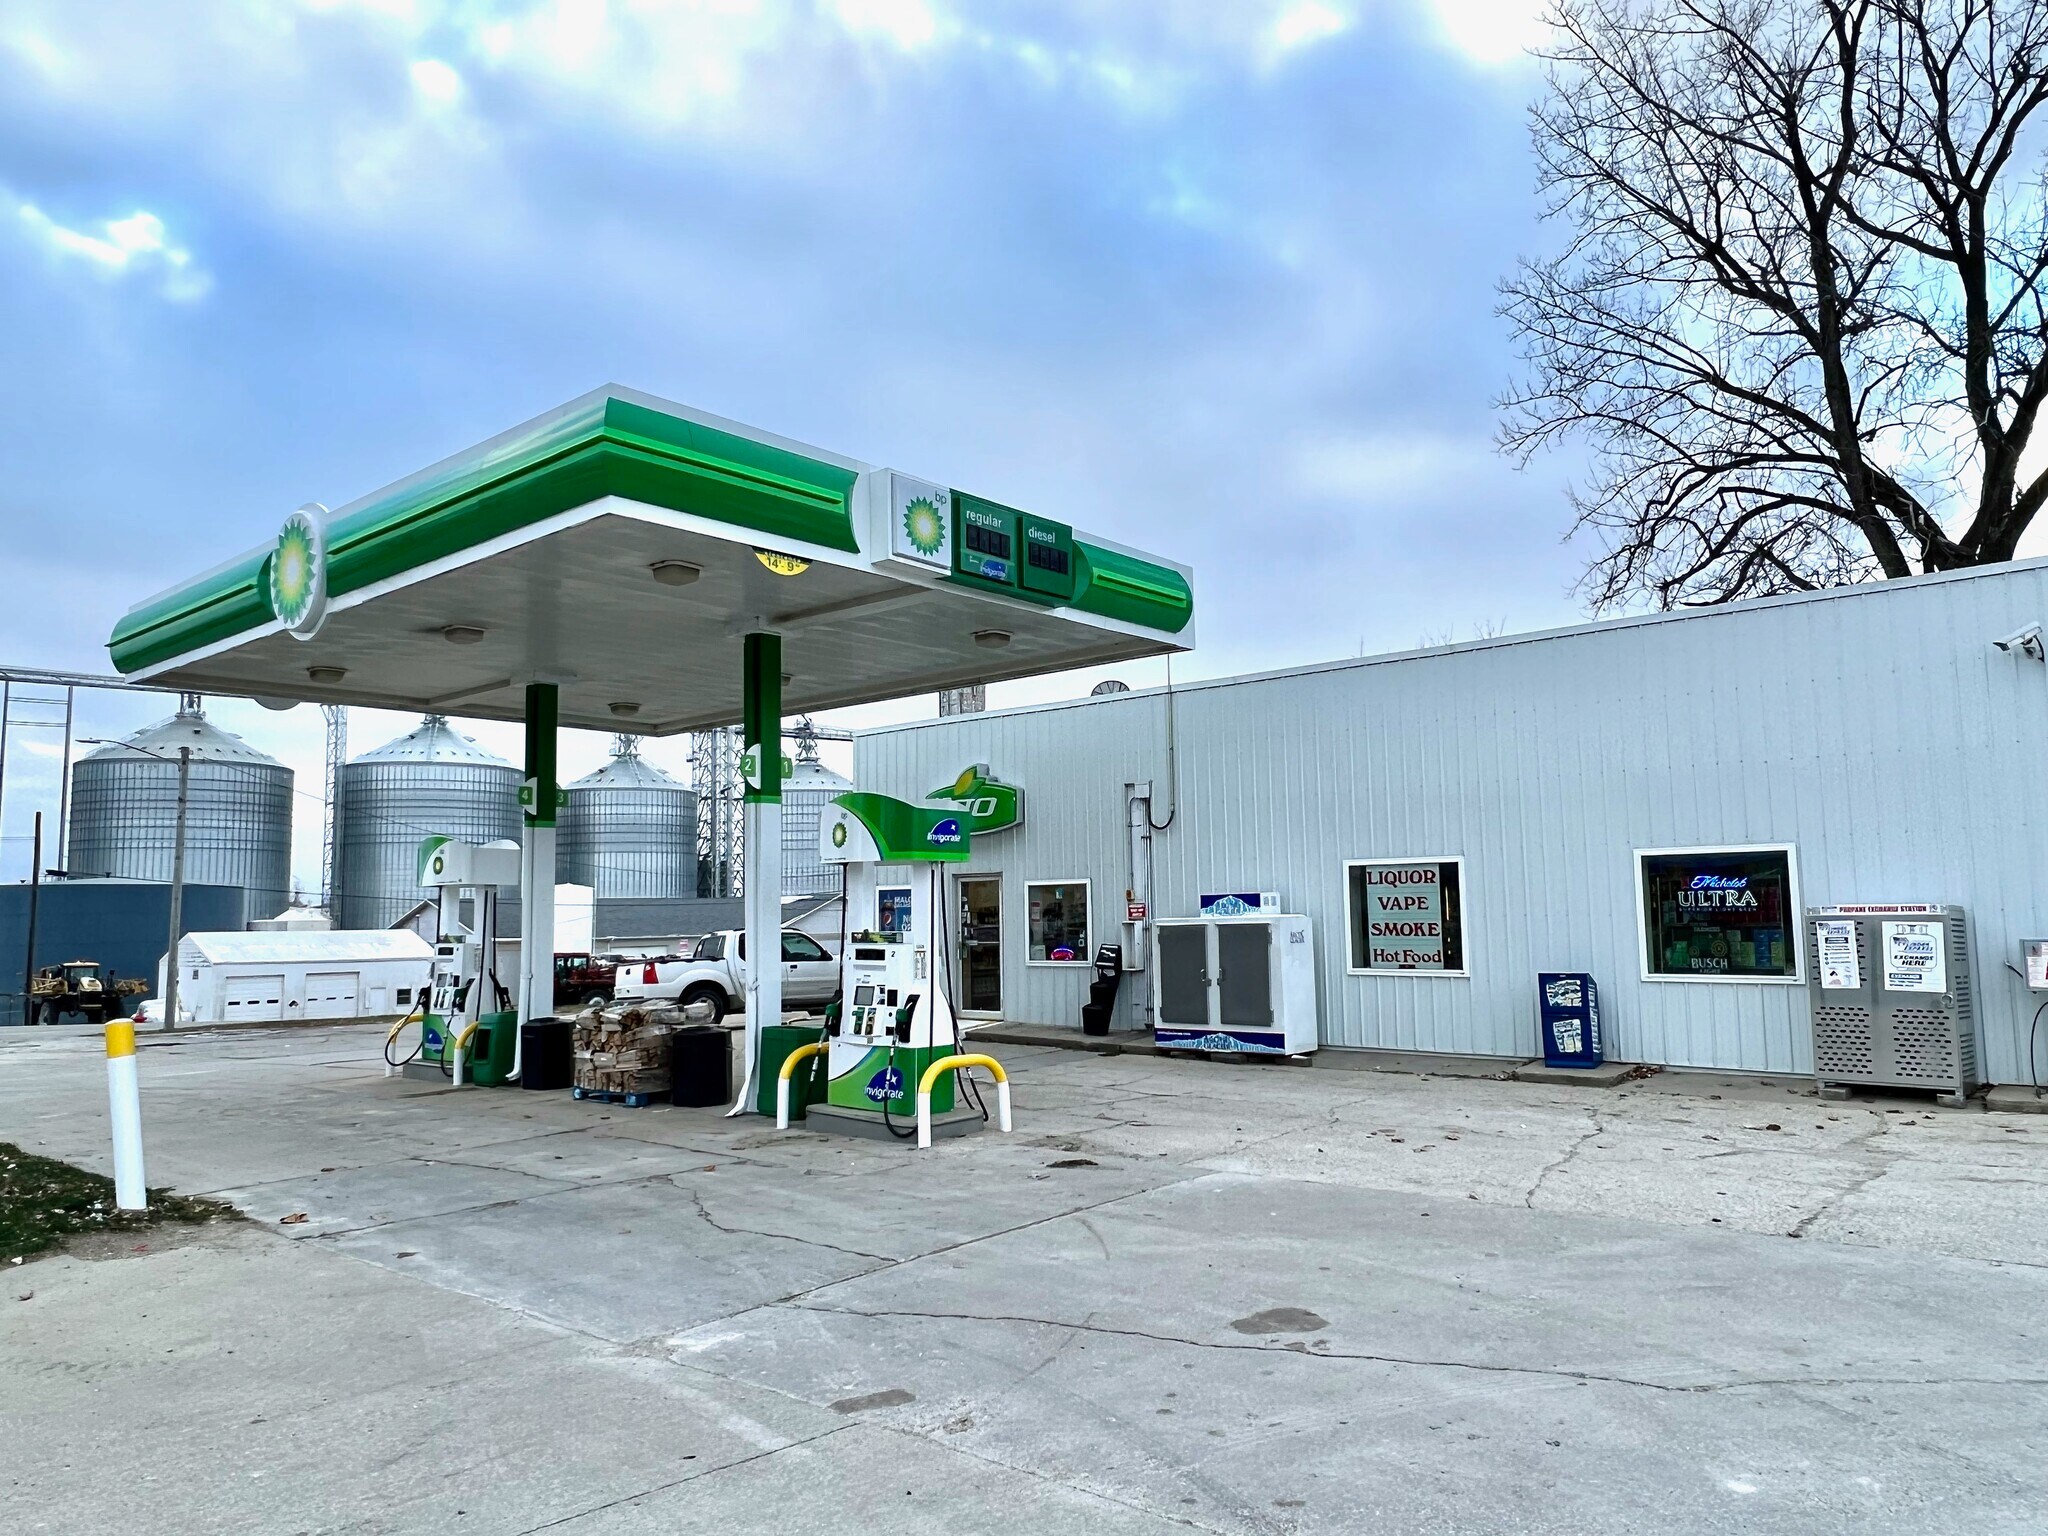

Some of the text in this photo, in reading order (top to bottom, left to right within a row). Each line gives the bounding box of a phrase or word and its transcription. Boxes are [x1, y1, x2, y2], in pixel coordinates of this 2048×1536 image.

[935, 490, 947, 505] bp
[966, 510, 1002, 528] regular
[1028, 526, 1056, 544] diesel
[745, 758, 752, 771] 2
[783, 760, 789, 773] 1
[521, 790, 529, 801] 4
[557, 792, 564, 803] 3
[1366, 869, 1437, 888] LIQUOR
[1690, 875, 1748, 889] Michelob
[1377, 896, 1429, 911] VAPE
[1677, 889, 1758, 906] ULTRA
[1370, 922, 1441, 937] SMOKE
[890, 950, 896, 958] 2
[1373, 948, 1442, 963] Hot Food
[1691, 957, 1728, 969] BUSCH
